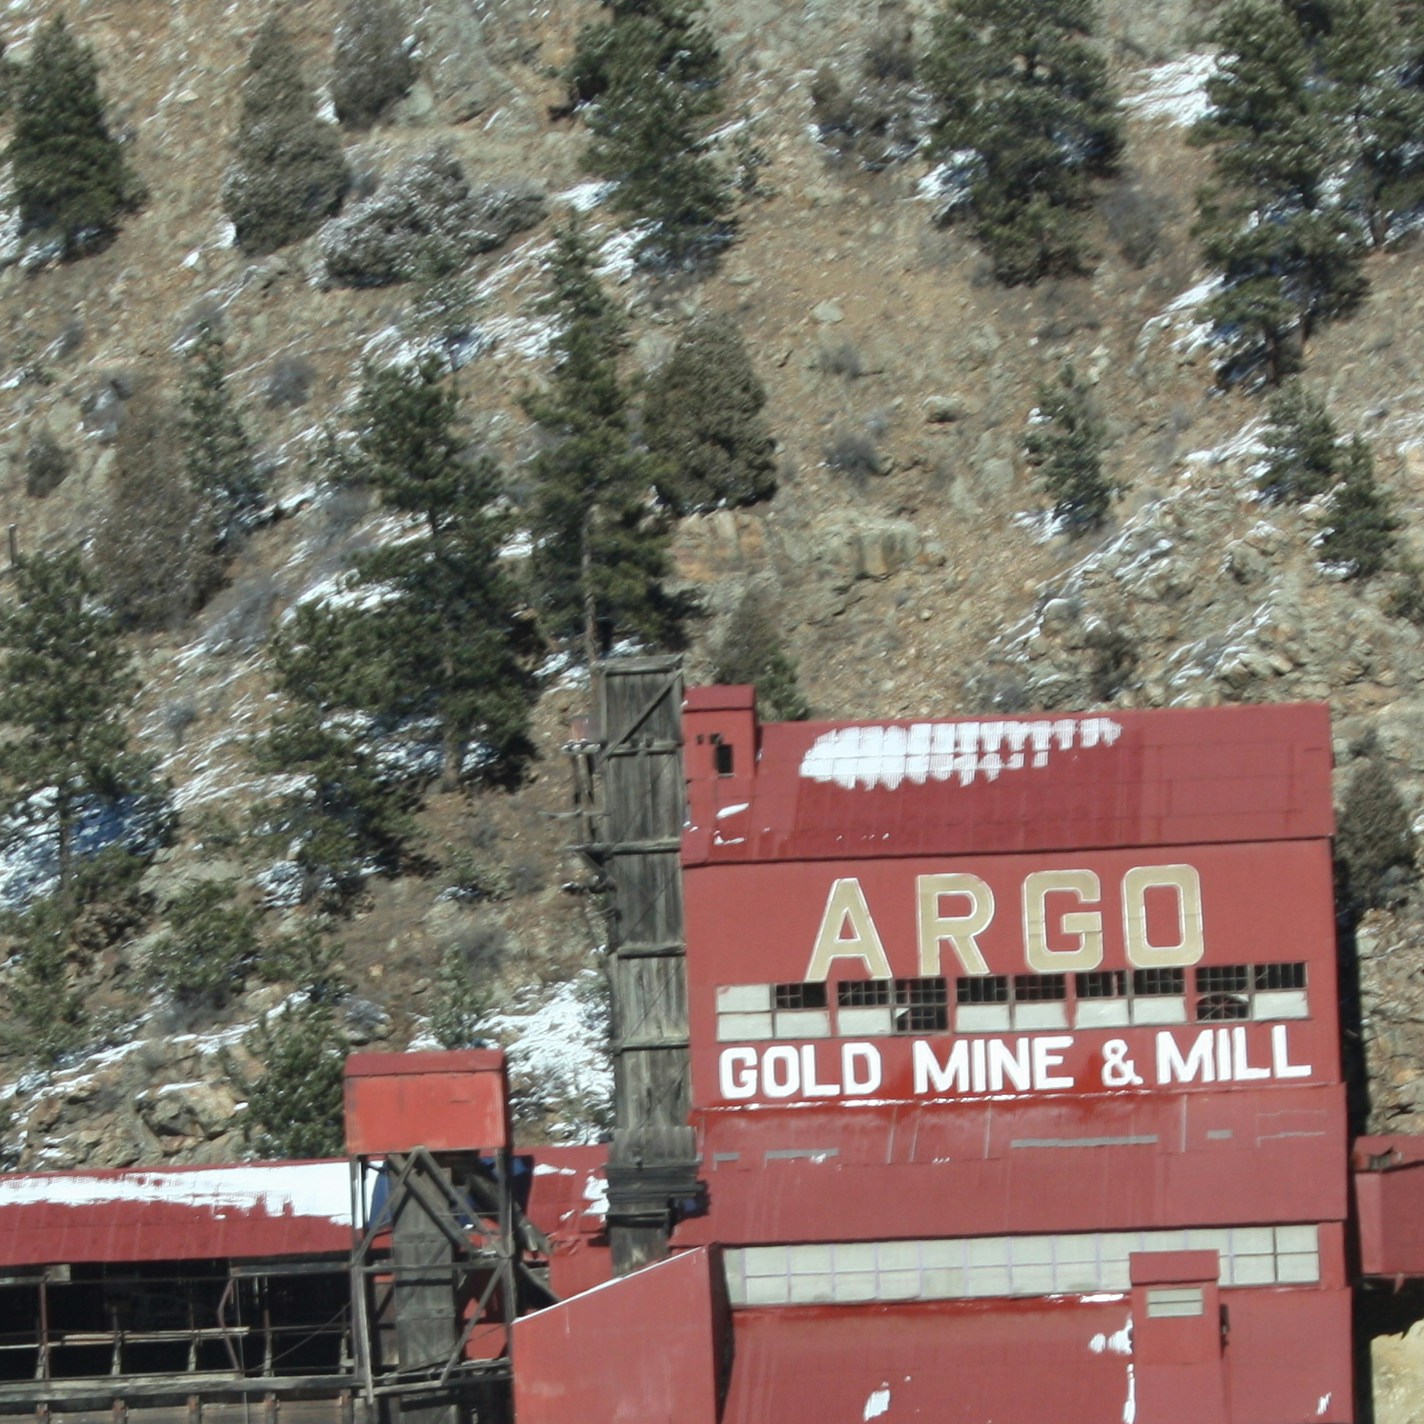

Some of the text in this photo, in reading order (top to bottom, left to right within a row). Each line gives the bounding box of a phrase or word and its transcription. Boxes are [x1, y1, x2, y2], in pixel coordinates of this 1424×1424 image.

[805, 864, 1205, 980] ARGO
[718, 1025, 1312, 1099] GOLD MINE & MILL
